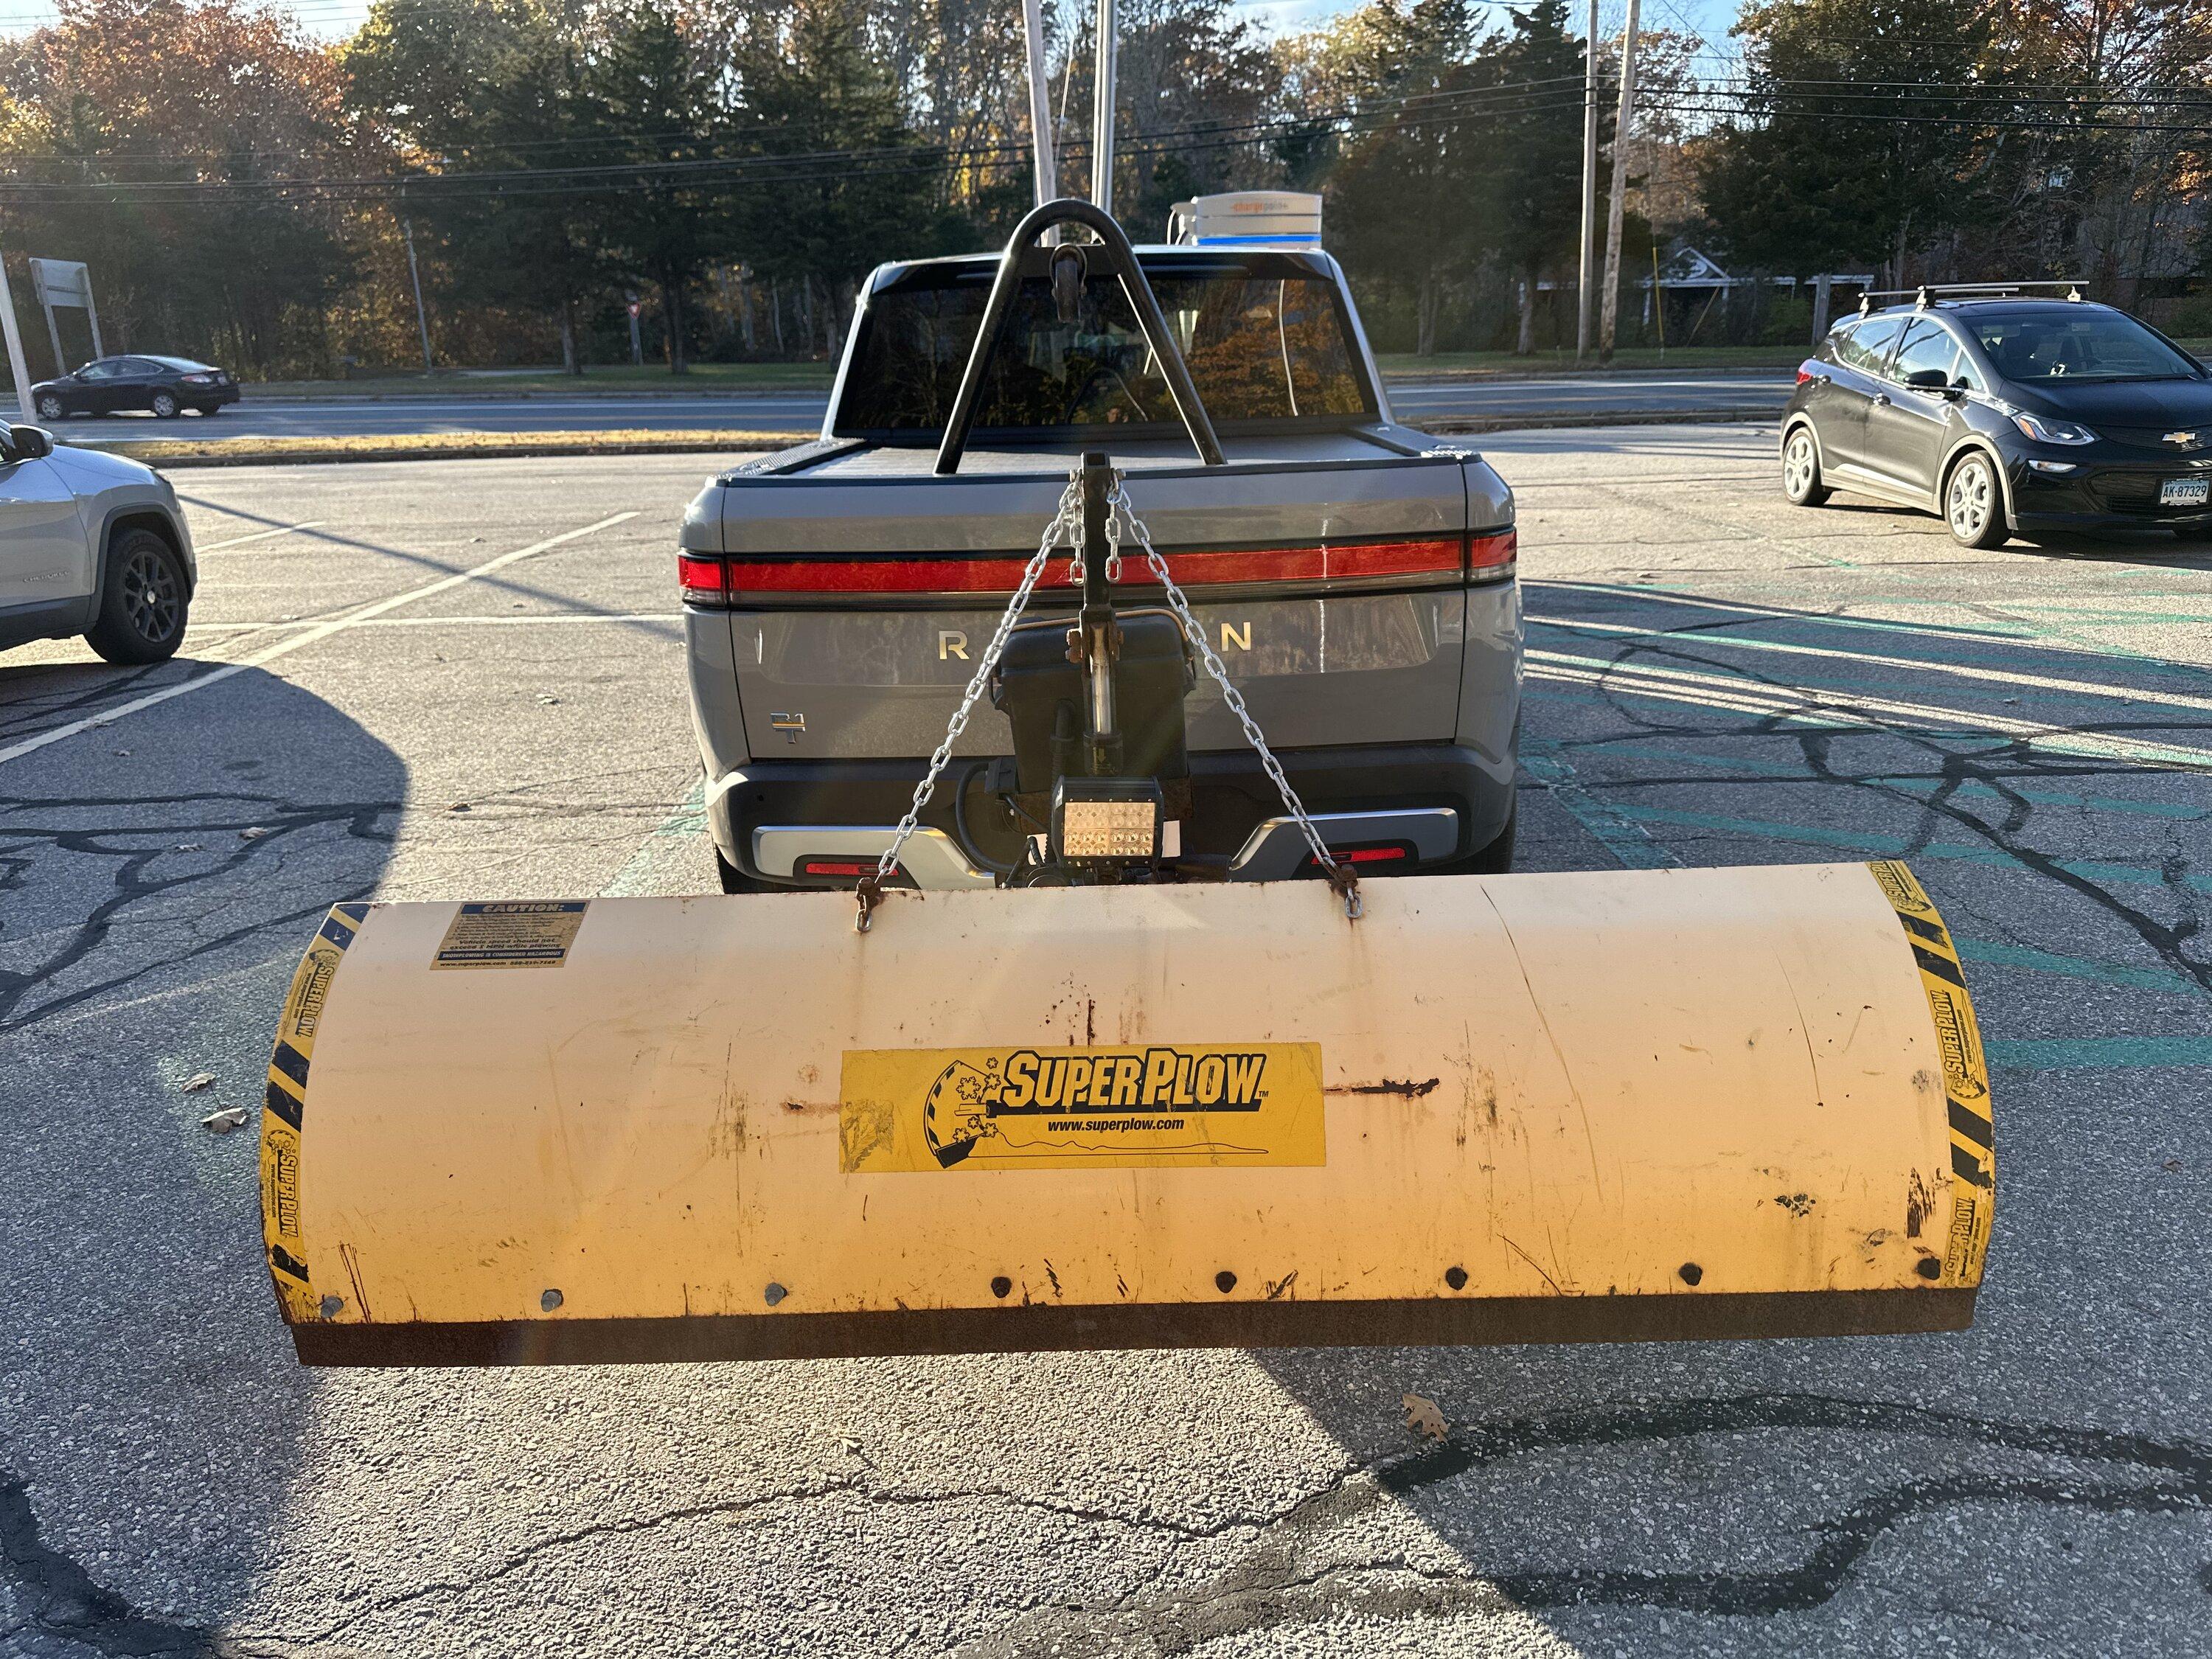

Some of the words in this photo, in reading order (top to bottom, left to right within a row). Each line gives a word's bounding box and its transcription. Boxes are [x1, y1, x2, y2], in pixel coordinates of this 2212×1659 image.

[482, 903, 565, 913] CAUTION:
[1930, 990, 1964, 1074] SUPERPLOW
[1048, 1117, 1184, 1133] www.superplow.com
